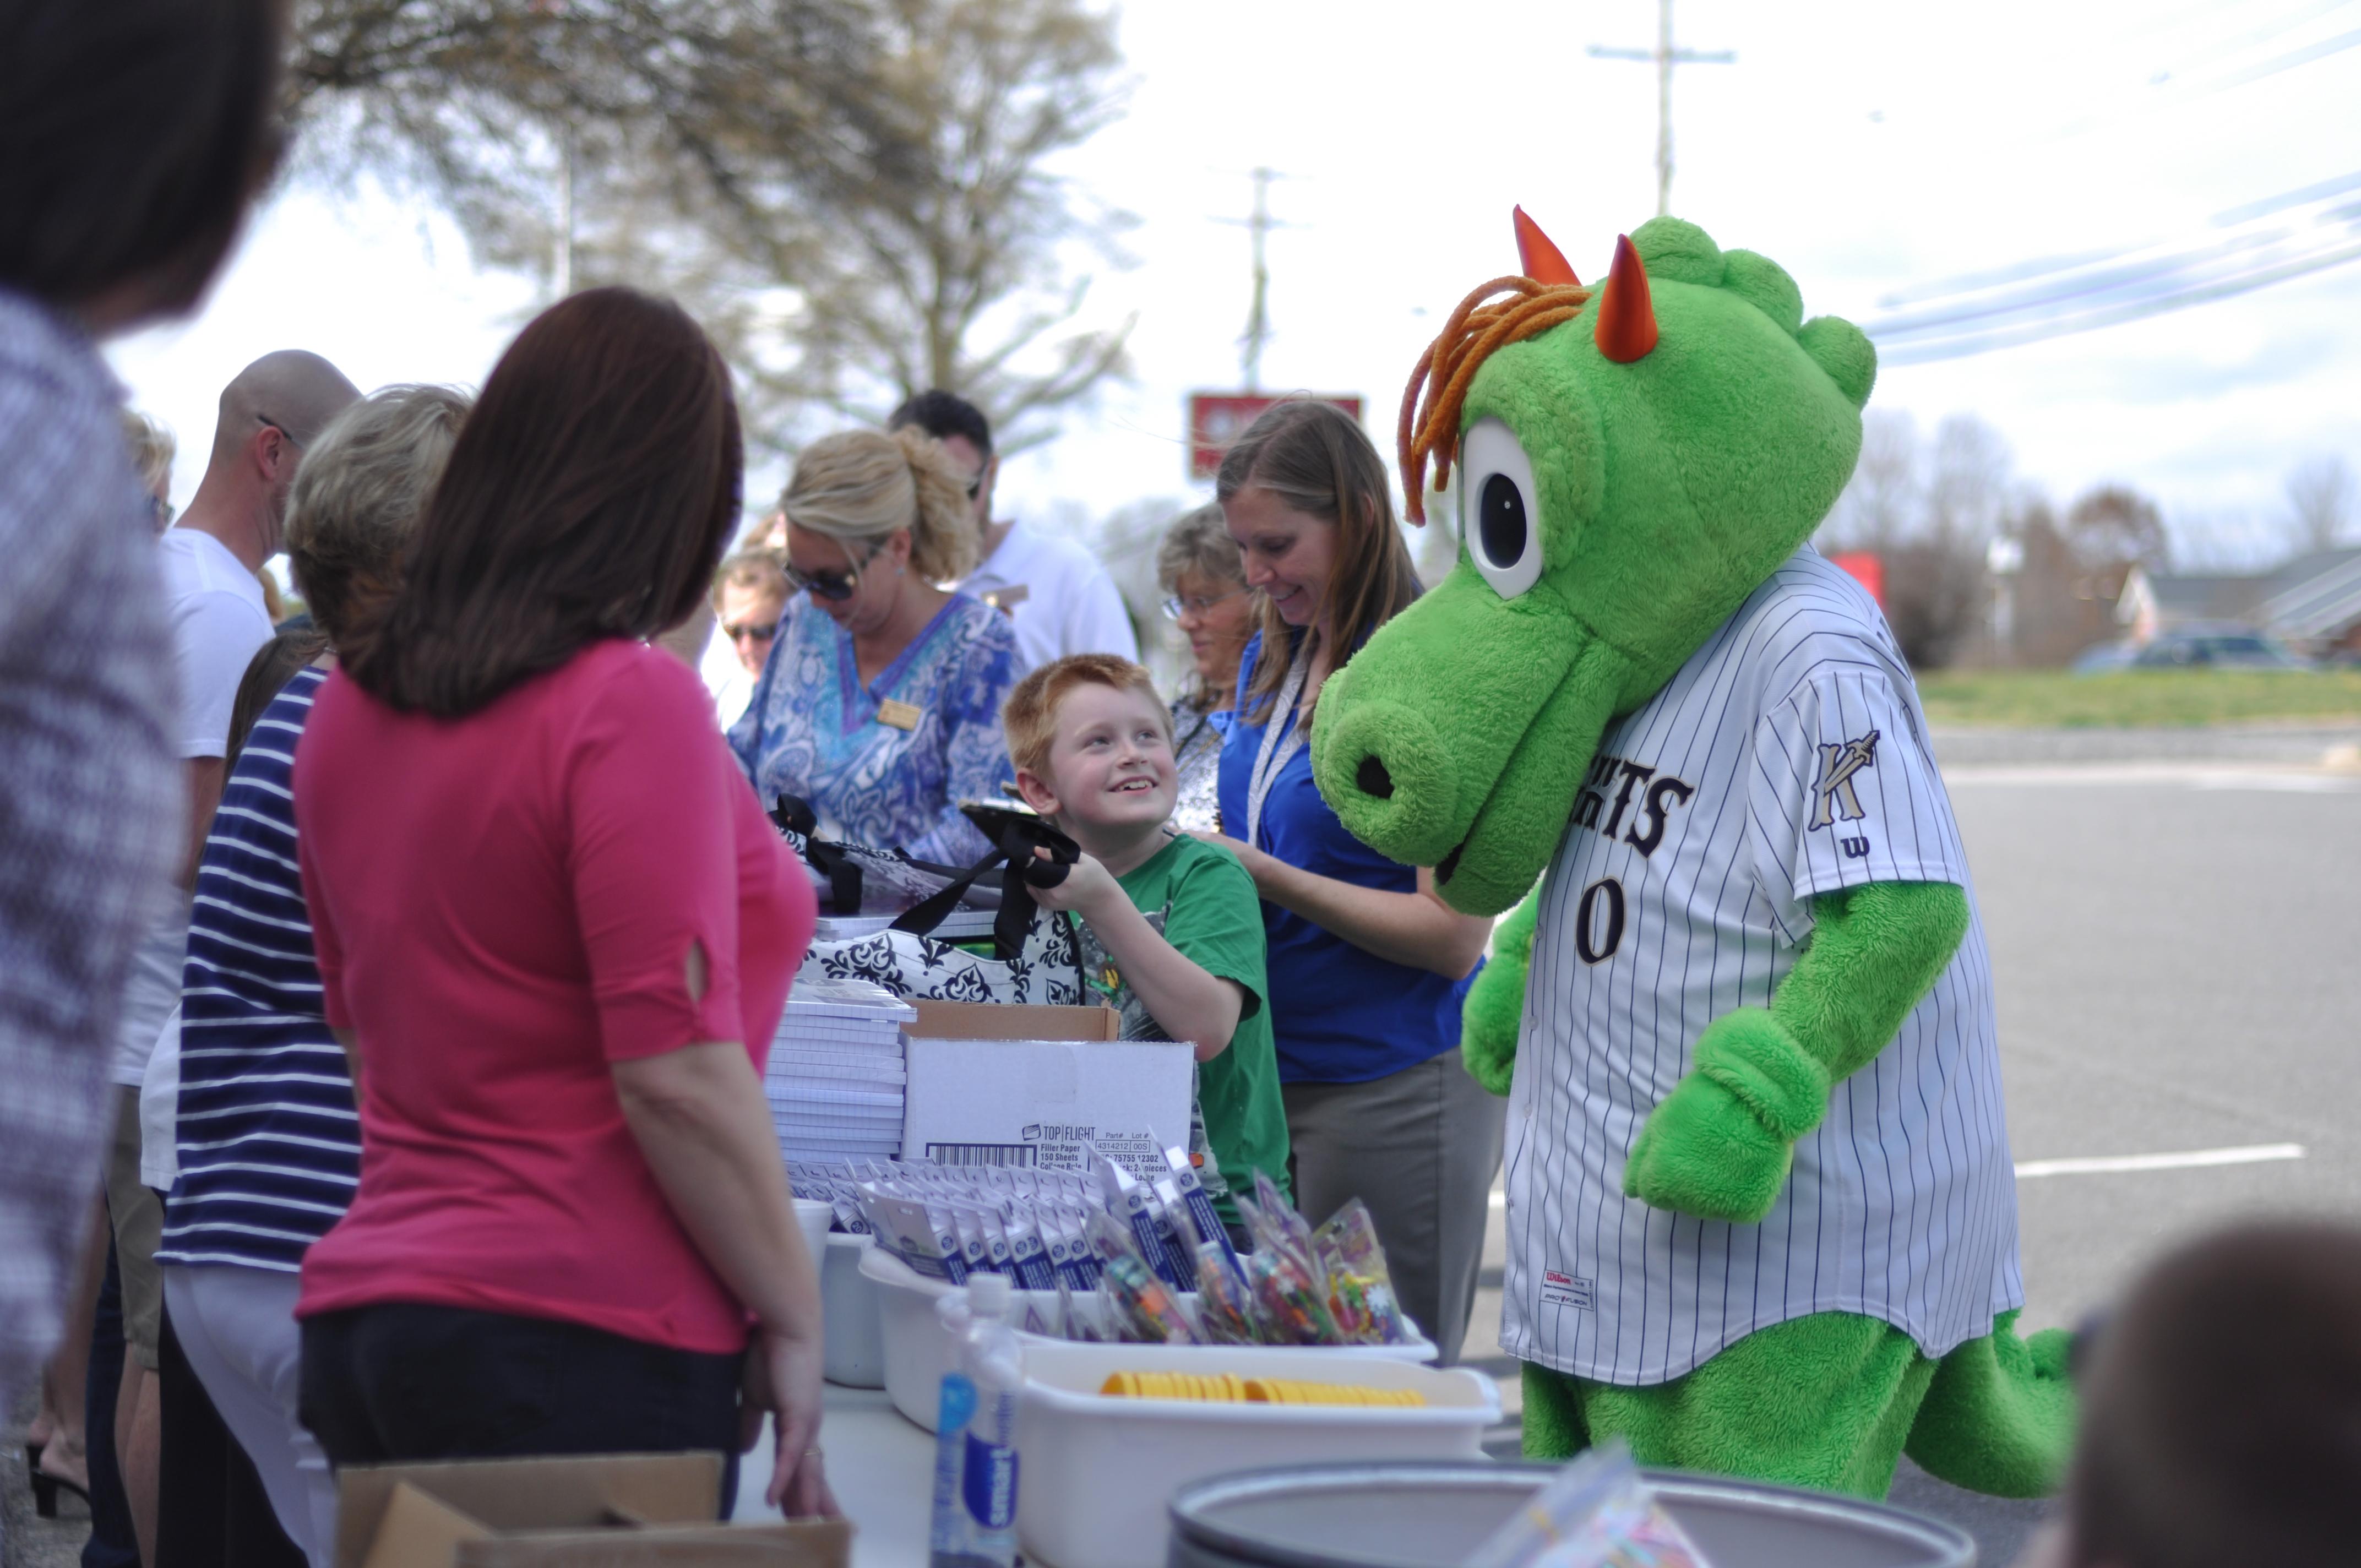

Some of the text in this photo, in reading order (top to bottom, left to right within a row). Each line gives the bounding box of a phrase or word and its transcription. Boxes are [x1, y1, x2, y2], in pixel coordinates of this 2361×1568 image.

[1568, 754, 1695, 861] HTS
[1041, 1144, 1080, 1153] Filler Paper
[1041, 1153, 1079, 1161] 150 Sheets
[1114, 1154, 1135, 1162] 75755
[1138, 1155, 1158, 1163] 12302
[1135, 1173, 1155, 1182] Loe
[852, 1222, 862, 1233] 20
[1547, 1272, 1571, 1285] Wilson
